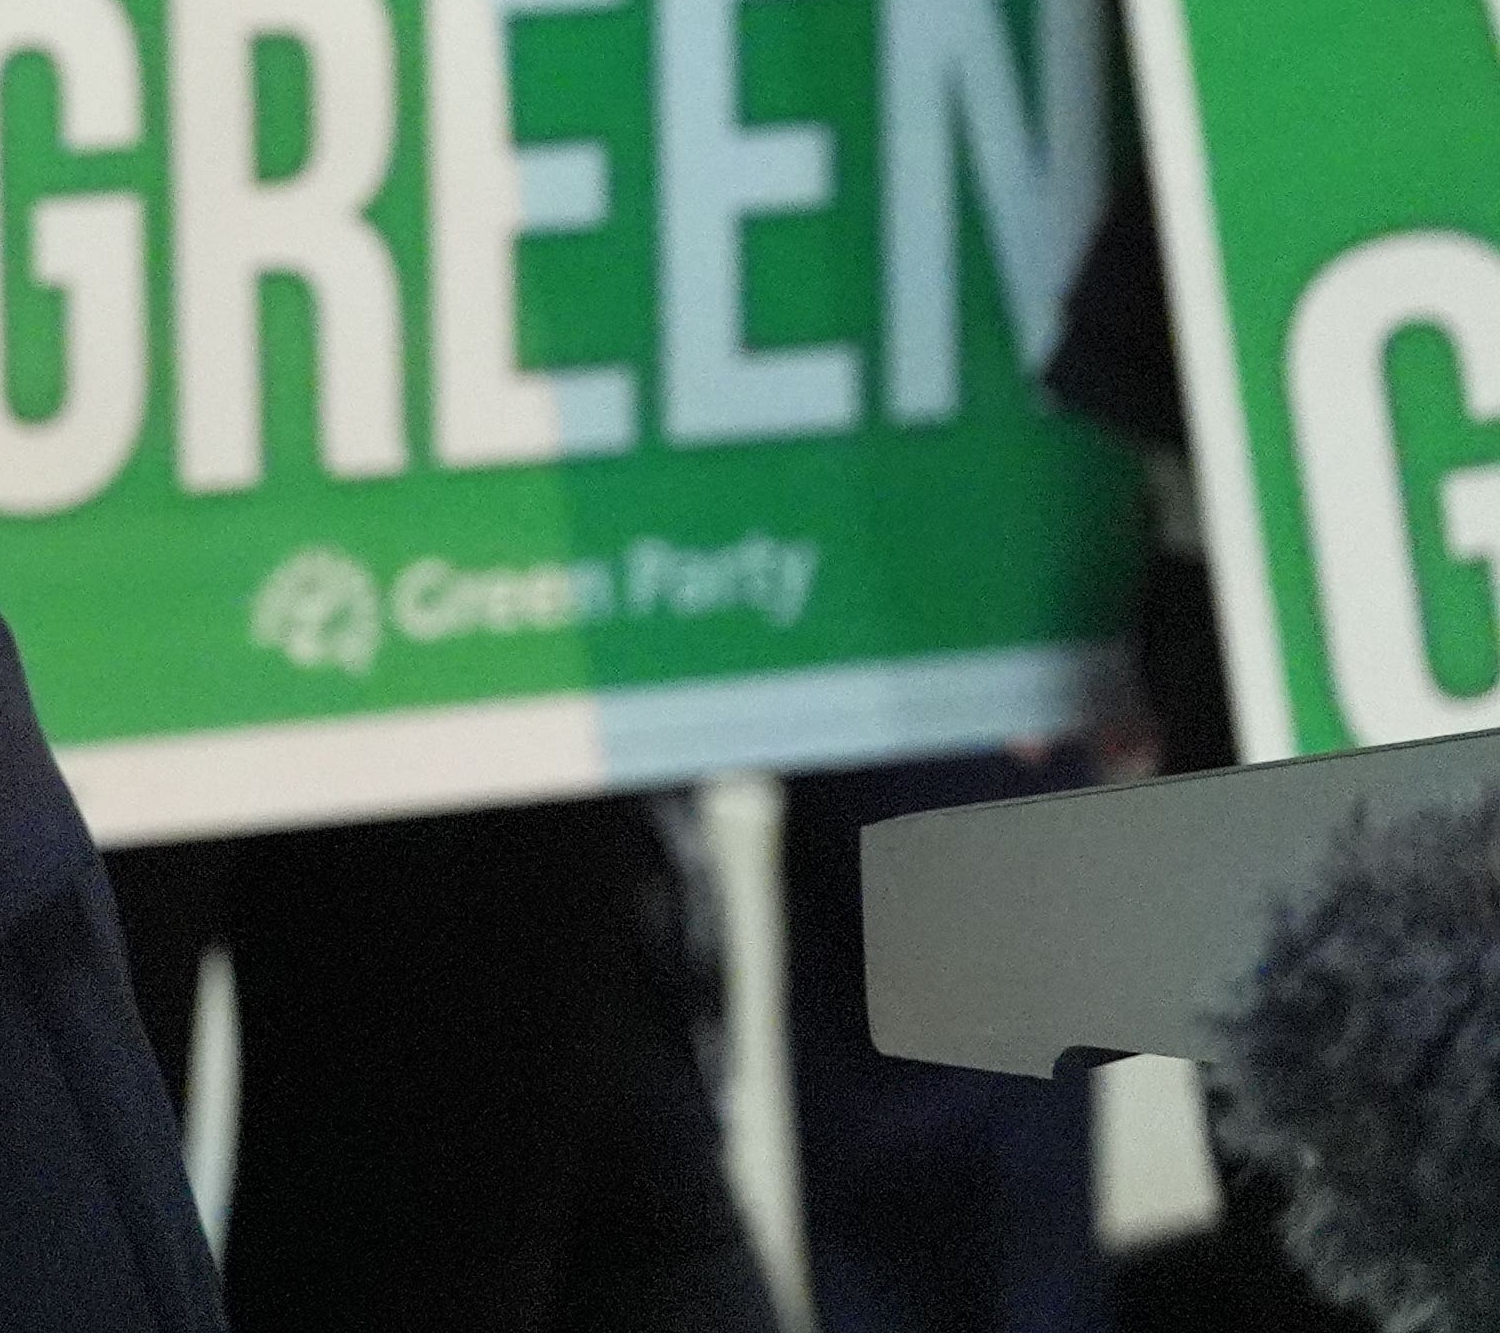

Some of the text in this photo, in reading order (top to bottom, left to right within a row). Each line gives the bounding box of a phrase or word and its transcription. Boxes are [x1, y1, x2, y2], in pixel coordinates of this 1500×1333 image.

[392, 529, 820, 641] Green Party
[1285, 227, 1500, 748] G
